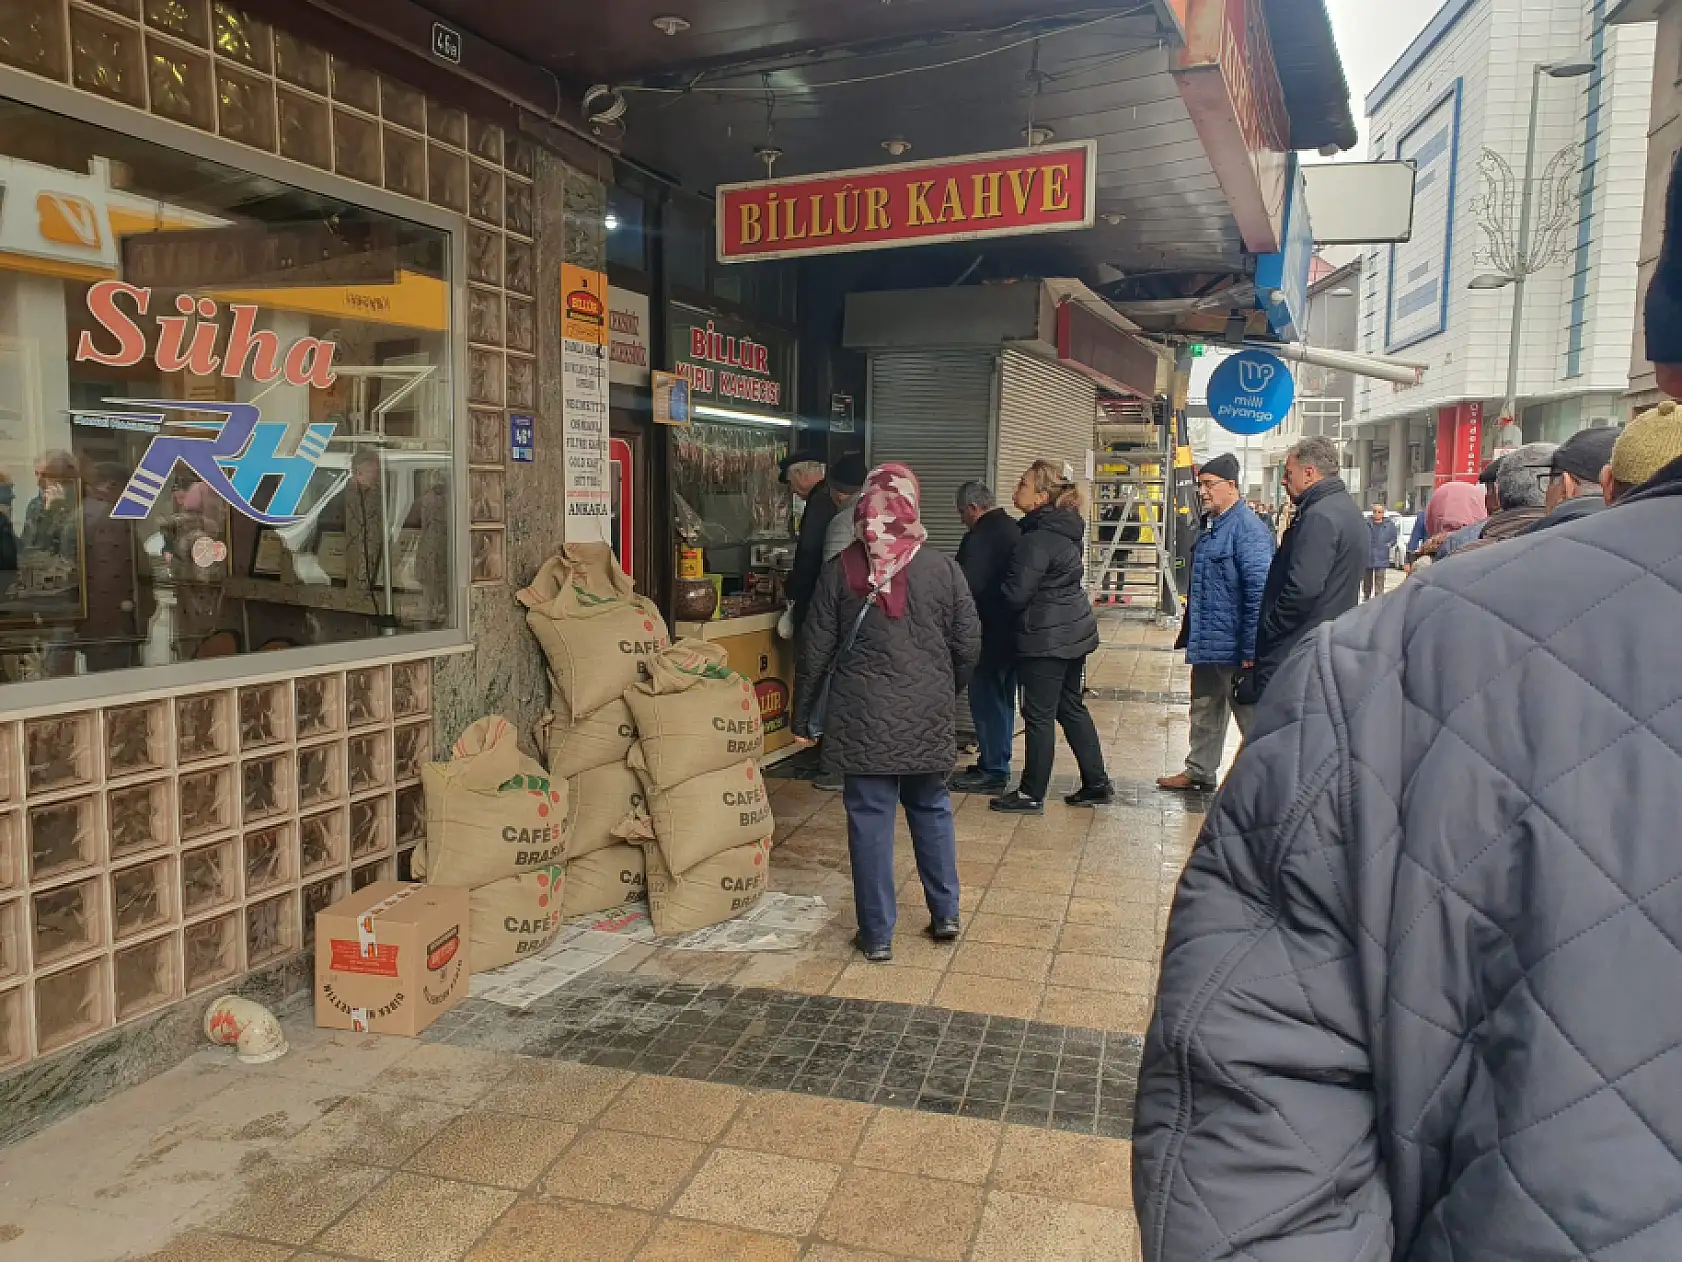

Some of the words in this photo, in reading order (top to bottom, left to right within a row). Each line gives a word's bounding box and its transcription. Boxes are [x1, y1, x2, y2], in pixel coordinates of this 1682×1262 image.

[739, 184, 892, 245] BİLLÛR
[906, 163, 1070, 227] KAHVE
[75, 279, 338, 389] Süha
[690, 320, 770, 376] BİLLÛR
[568, 503, 608, 516] ANKARA
